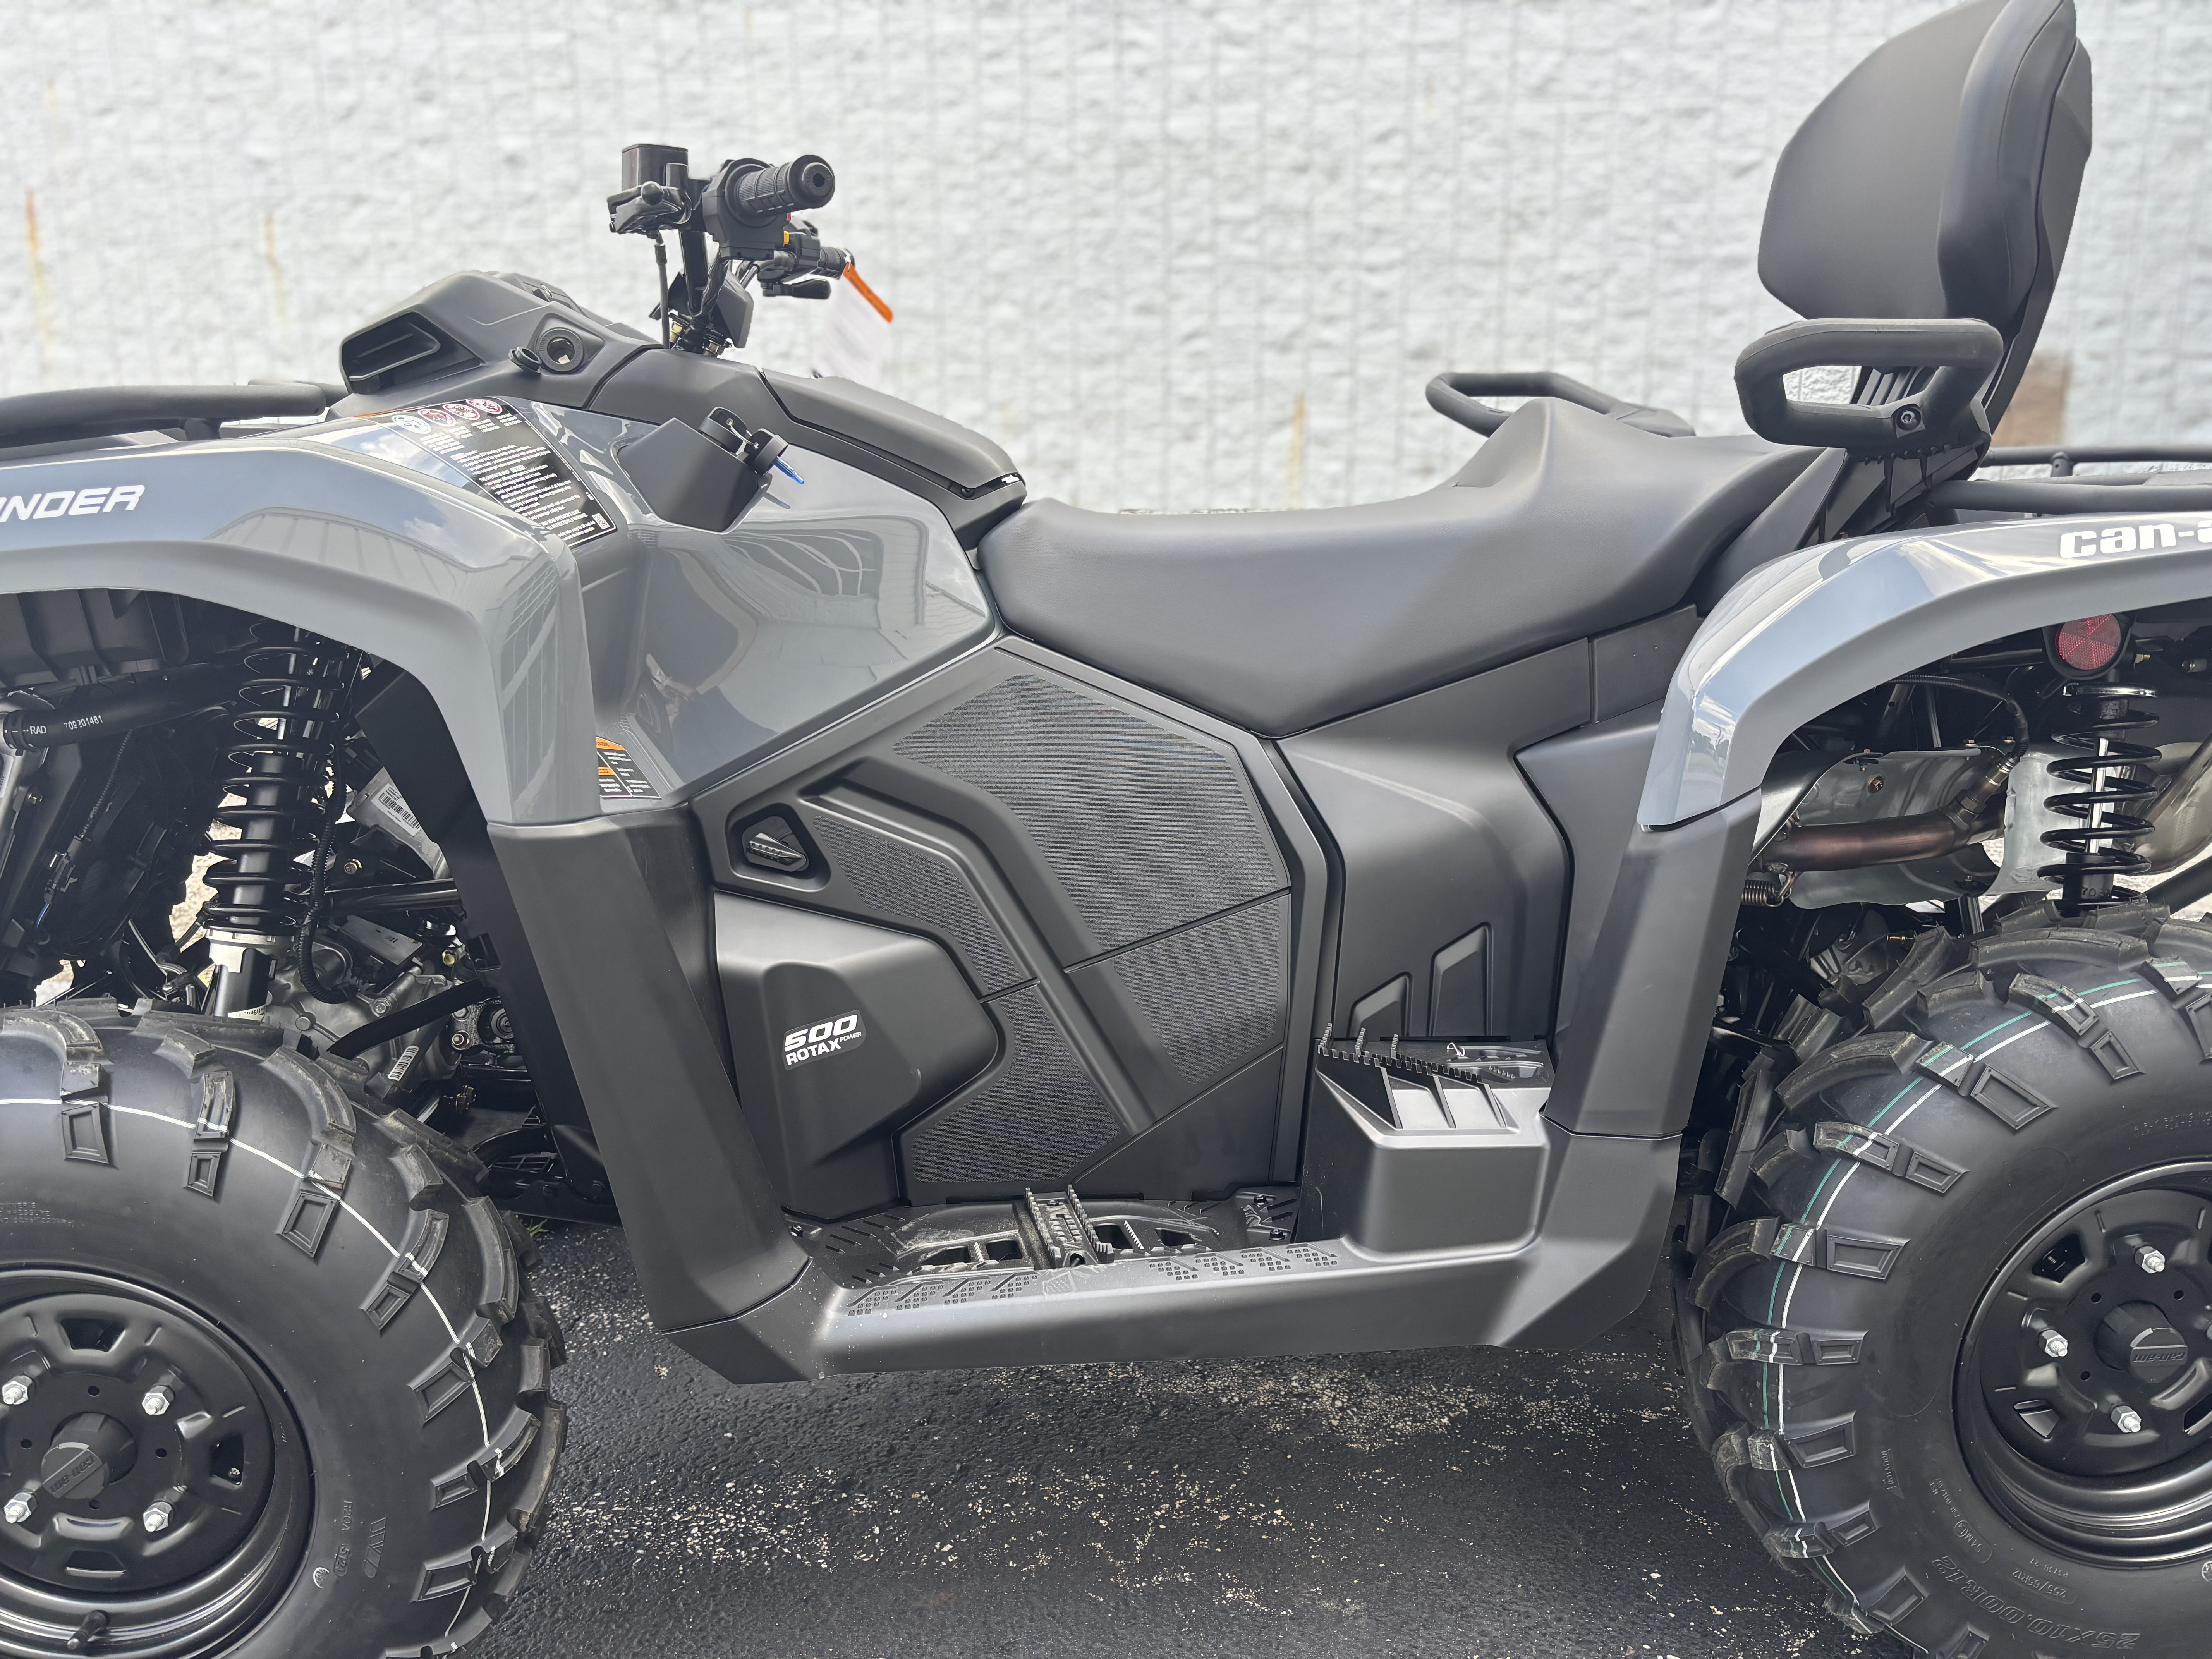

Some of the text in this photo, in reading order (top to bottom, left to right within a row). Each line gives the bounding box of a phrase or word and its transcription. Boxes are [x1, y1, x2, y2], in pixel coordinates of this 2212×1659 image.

[0, 484, 145, 523] NDER
[29, 725, 47, 735] RAD
[784, 1014, 858, 1052] 500
[785, 1031, 862, 1066] ROTAX POWER
[2133, 1351, 2186, 1363] can-am
[50, 1455, 96, 1495] can-am
[2012, 1567, 2068, 1599] 255/65R12
[1932, 1555, 2141, 1650] 25X10.00R12
